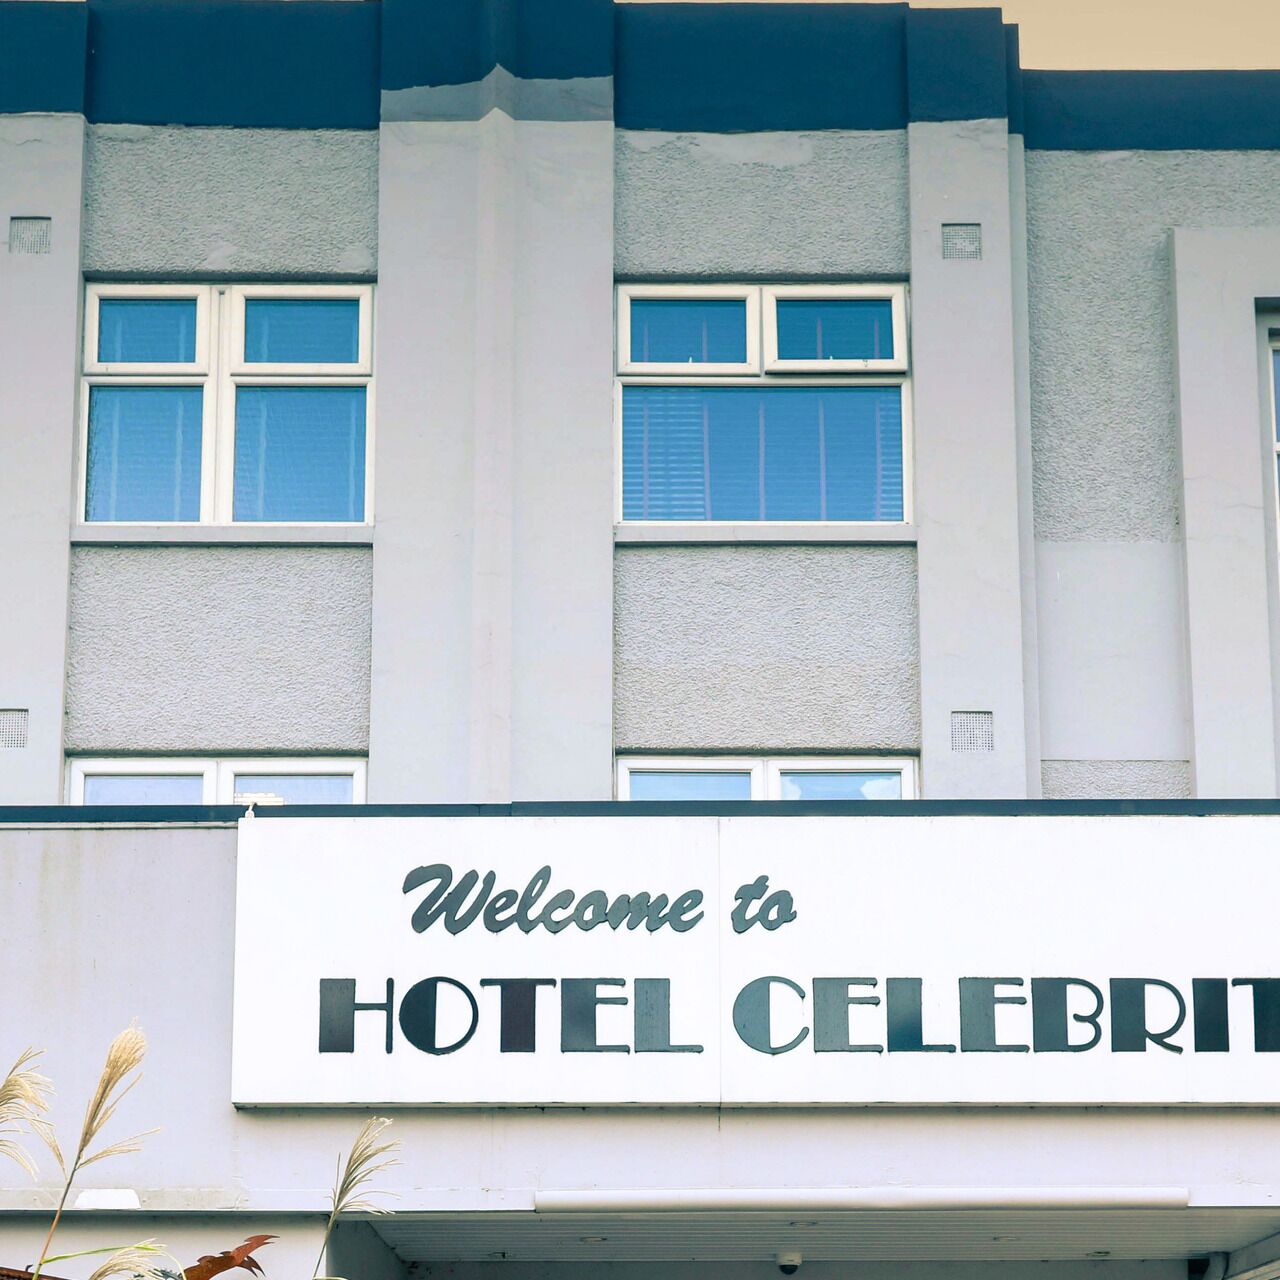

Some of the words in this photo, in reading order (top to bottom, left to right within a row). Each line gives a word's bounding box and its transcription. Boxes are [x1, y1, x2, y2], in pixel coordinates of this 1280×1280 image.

[402, 863, 705, 937] Welcome
[730, 875, 798, 935] to
[318, 976, 704, 1056] HOTEL
